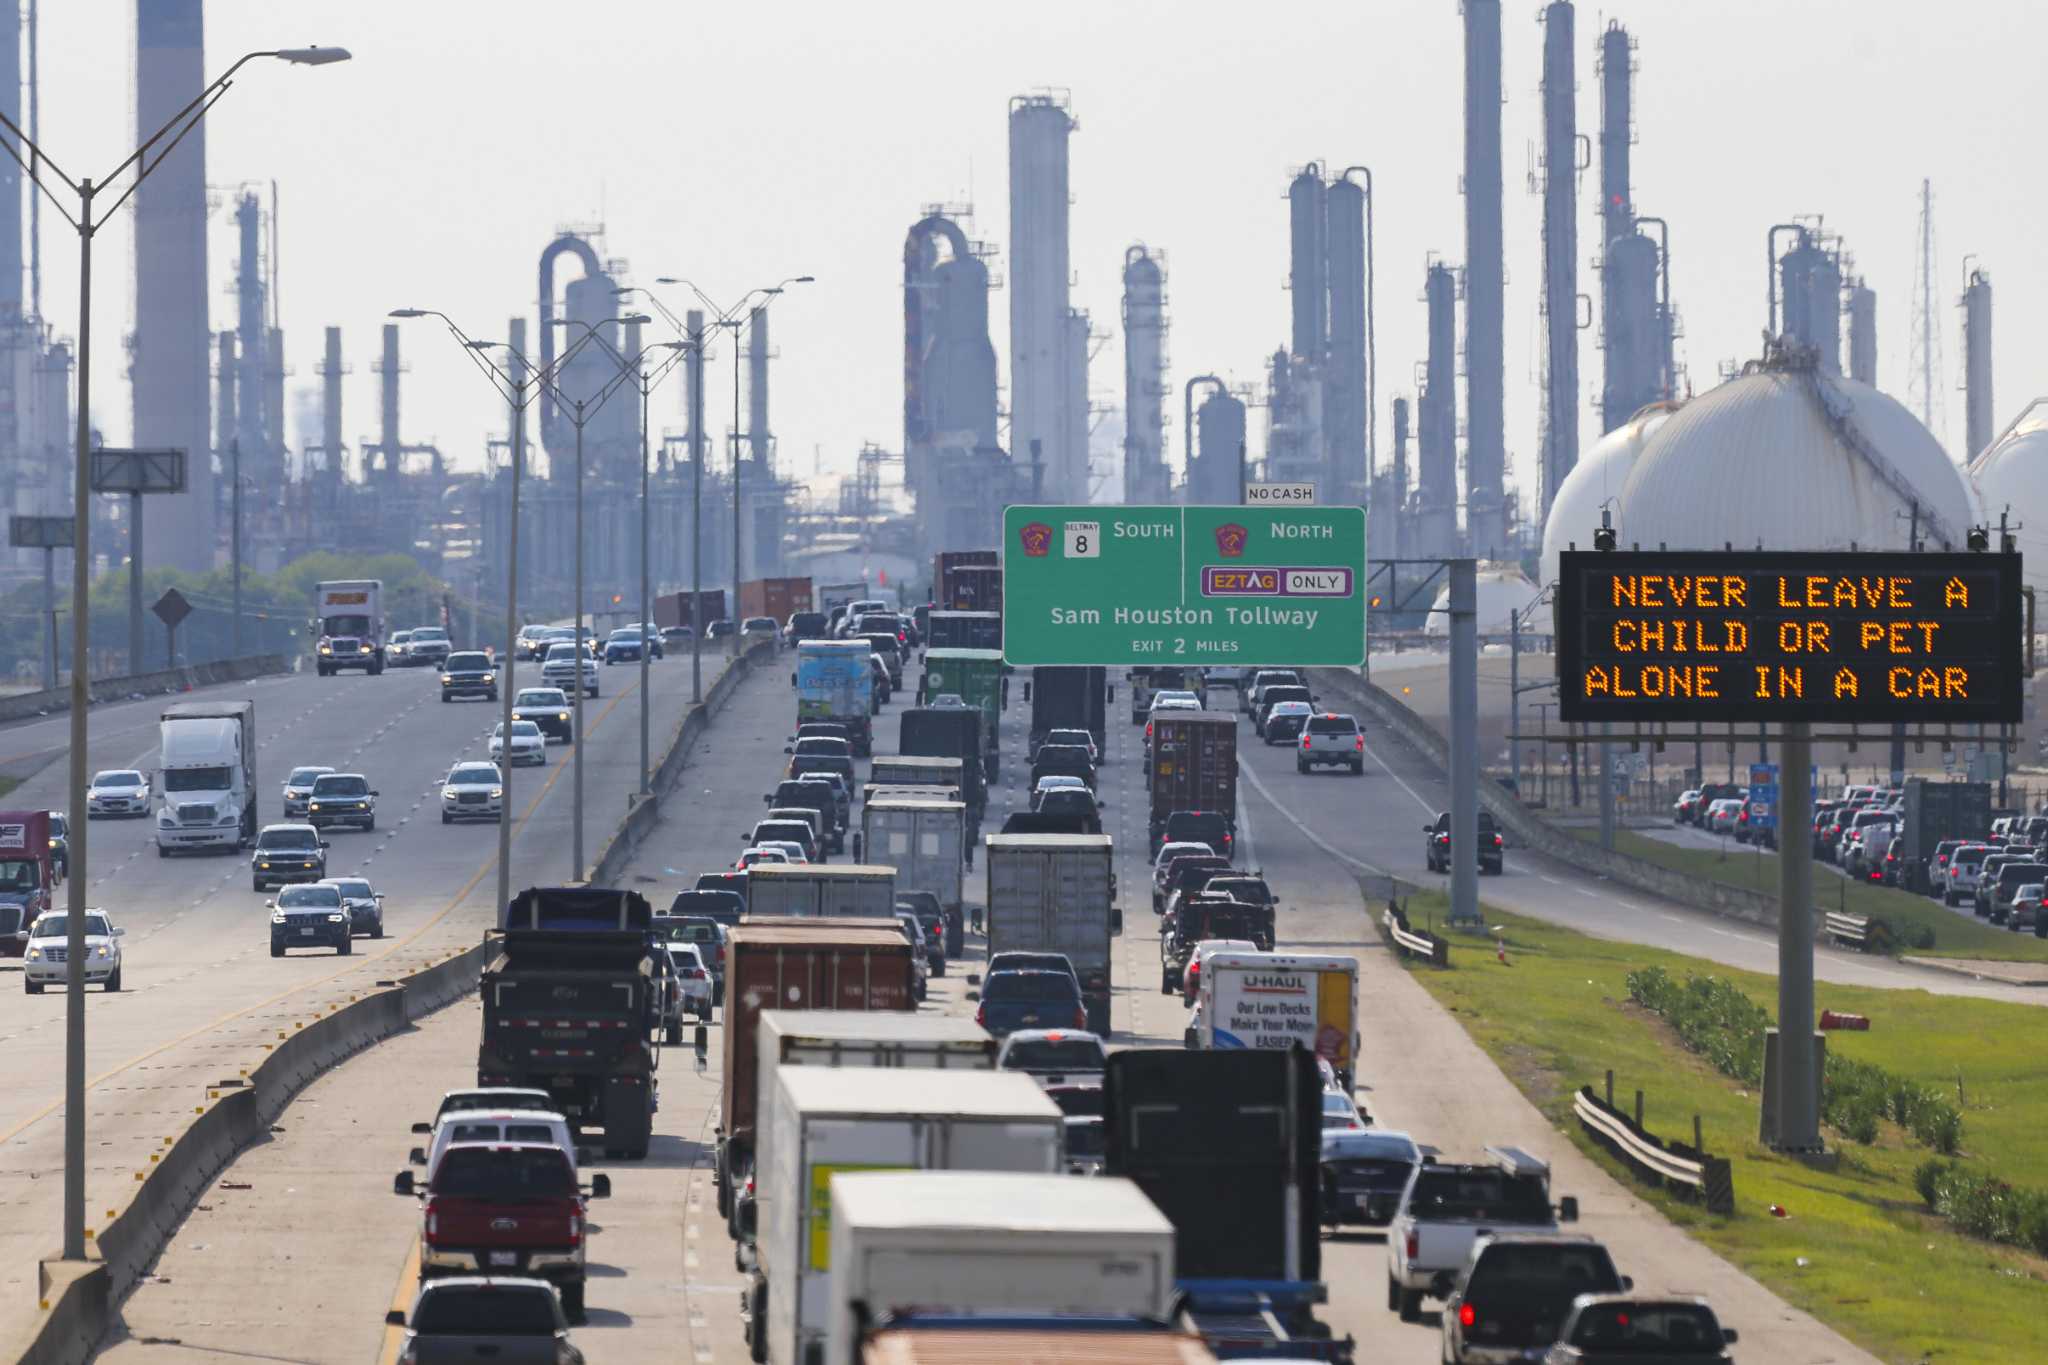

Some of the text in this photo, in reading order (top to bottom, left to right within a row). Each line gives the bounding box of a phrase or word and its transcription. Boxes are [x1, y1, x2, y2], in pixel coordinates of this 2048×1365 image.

[1249, 488, 1313, 500] NO CASH
[1114, 521, 1174, 538] SOUTH
[1271, 522, 1333, 539] NORTH
[1076, 535, 1088, 554] 8
[1292, 575, 1339, 589] ONLY
[1612, 575, 1969, 608] NEVER LEAVE A
[1051, 606, 1318, 630] Sam Houston Tollway
[1613, 619, 1940, 653] CHILD OR PET
[1132, 638, 1239, 654] EXIT 2 MILES
[1585, 665, 1969, 698] ALONE IN A CAR
[1244, 976, 1307, 988] U-HAUL
[1237, 1002, 1311, 1015] Our Low Decks
[1231, 1018, 1259, 1031] Make
[1261, 1019, 1285, 1031] Your
